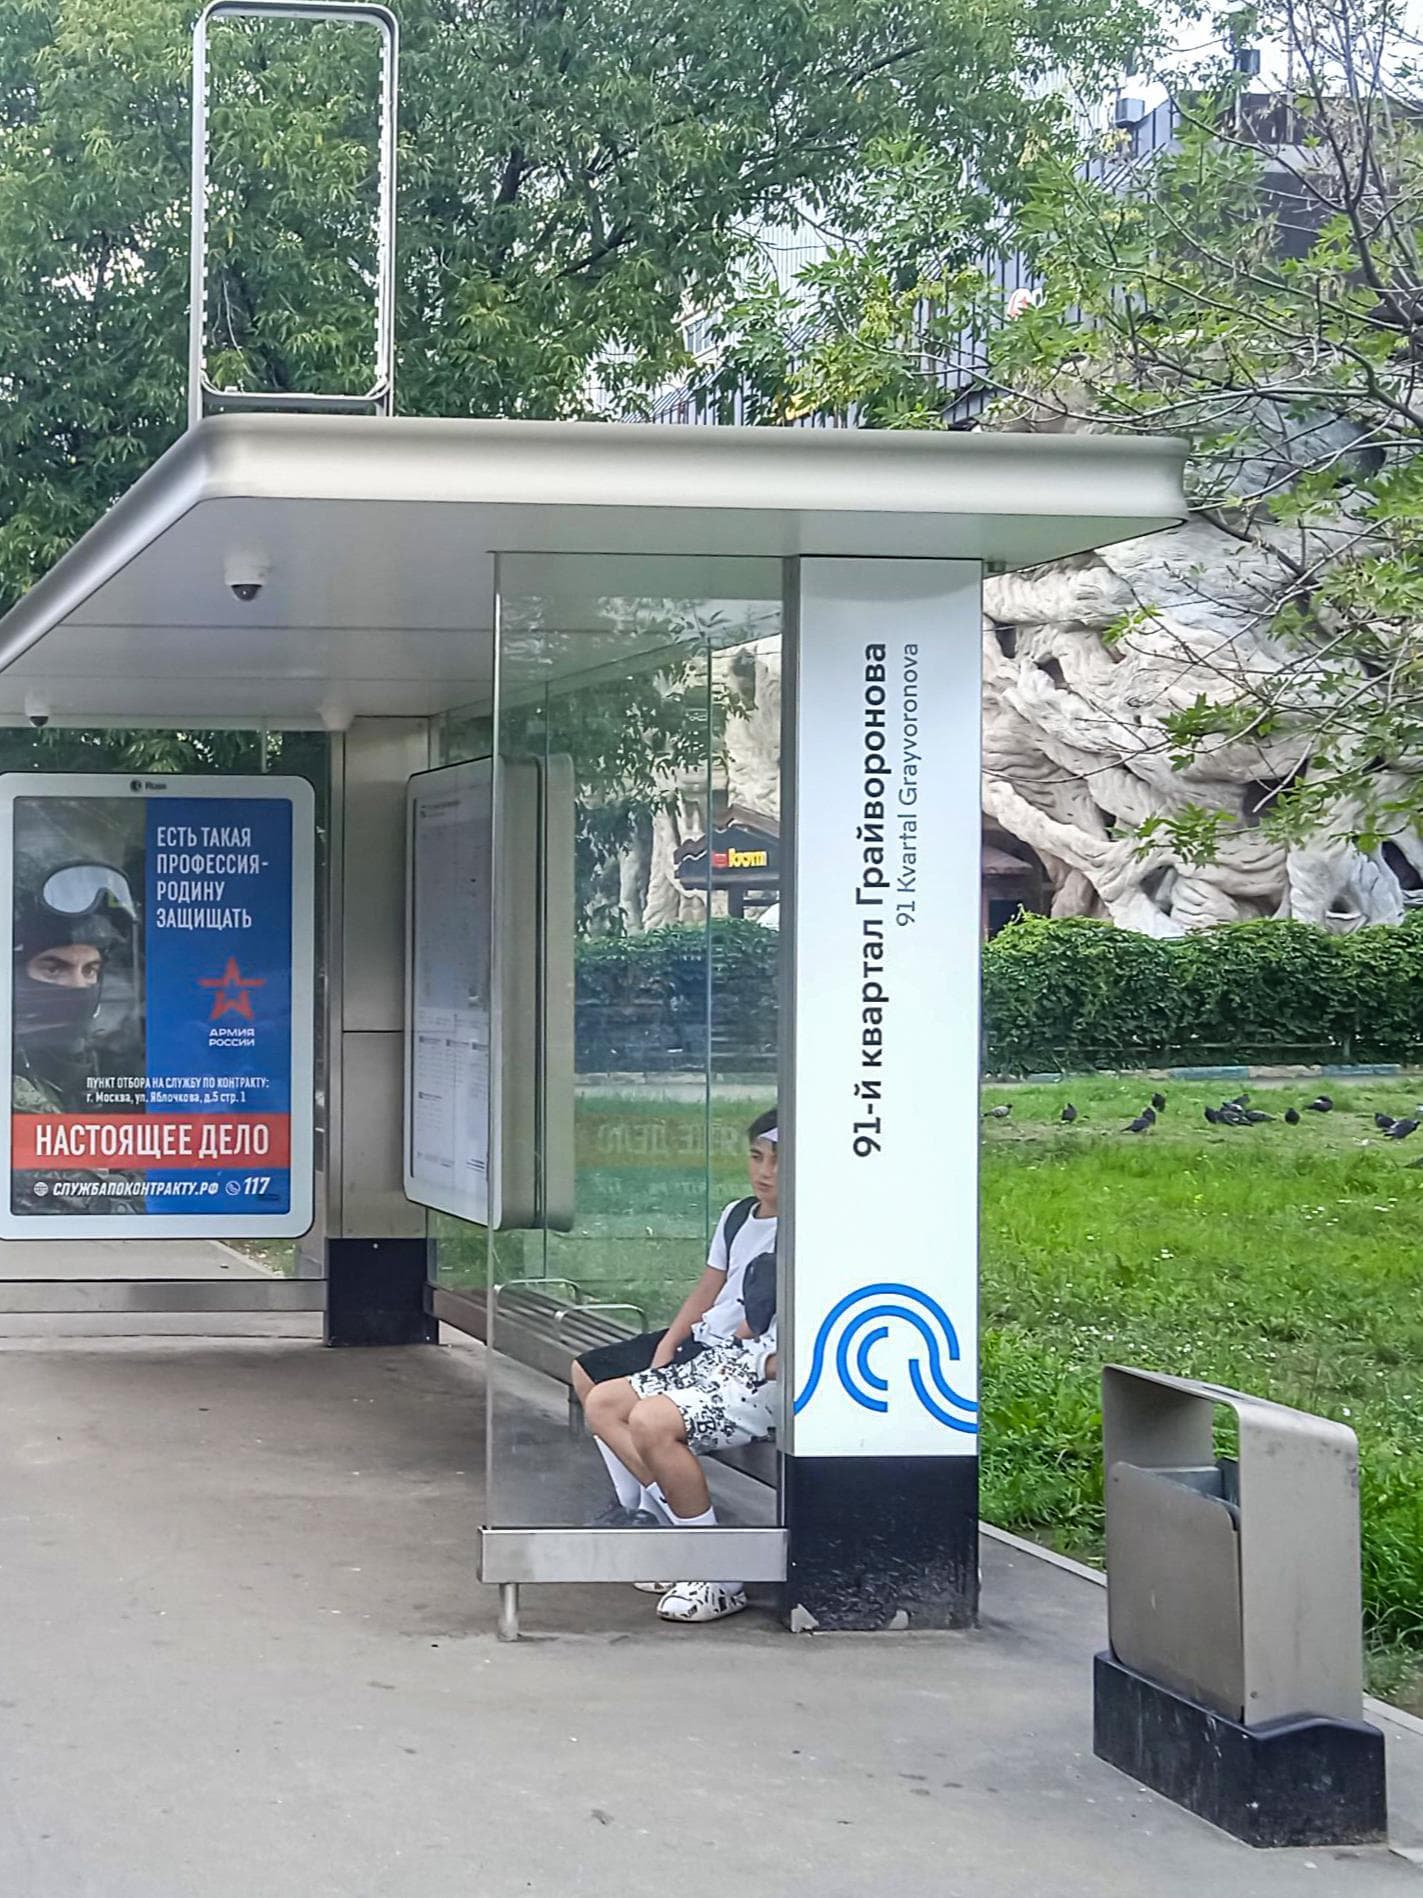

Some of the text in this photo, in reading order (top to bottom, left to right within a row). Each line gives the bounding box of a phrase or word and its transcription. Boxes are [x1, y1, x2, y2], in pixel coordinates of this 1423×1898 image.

[896, 643, 922, 927] 91 Kvartal Grayvoronova
[157, 826, 251, 847] ЕСТЬ ТАКАЯ
[157, 881, 225, 904] РОДИНУ
[853, 643, 892, 1158] 91-й квартал Грайворонова
[156, 908, 252, 931] ЗАЩИЩАТЬ
[209, 1028, 255, 1037] АРМИЯ
[208, 1038, 255, 1047] РОССИИ
[86, 1076, 270, 1089] ПУНКТ ОТБОРА НА СЛУЖБУ ПО КОНТРАКТУ:
[95, 1092, 134, 1105] Москва,
[35, 1124, 270, 1159] НАСТОЯЩЕЕ ДЕЛО
[52, 1181, 219, 1196] СЛУЖБАПОКОНТРАКТУ.РФ
[243, 1177, 271, 1195] 117
